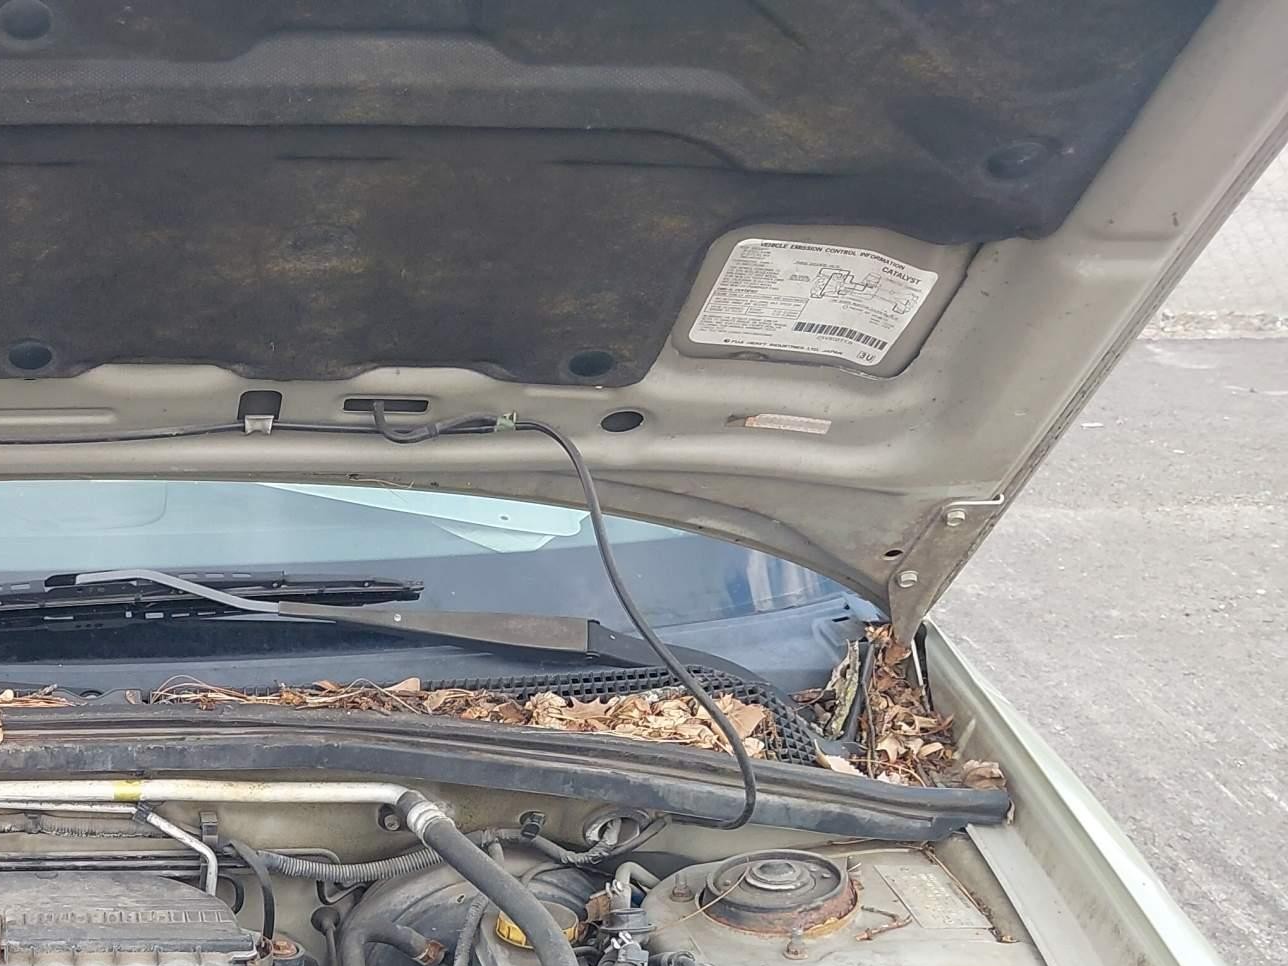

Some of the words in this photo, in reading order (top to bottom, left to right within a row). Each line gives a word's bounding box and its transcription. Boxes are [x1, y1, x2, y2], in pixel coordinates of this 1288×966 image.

[790, 244, 823, 252] EMISSION
[825, 247, 856, 257] CONTROL
[860, 252, 906, 270] INFORMATION
[881, 266, 922, 285] CATALYST
